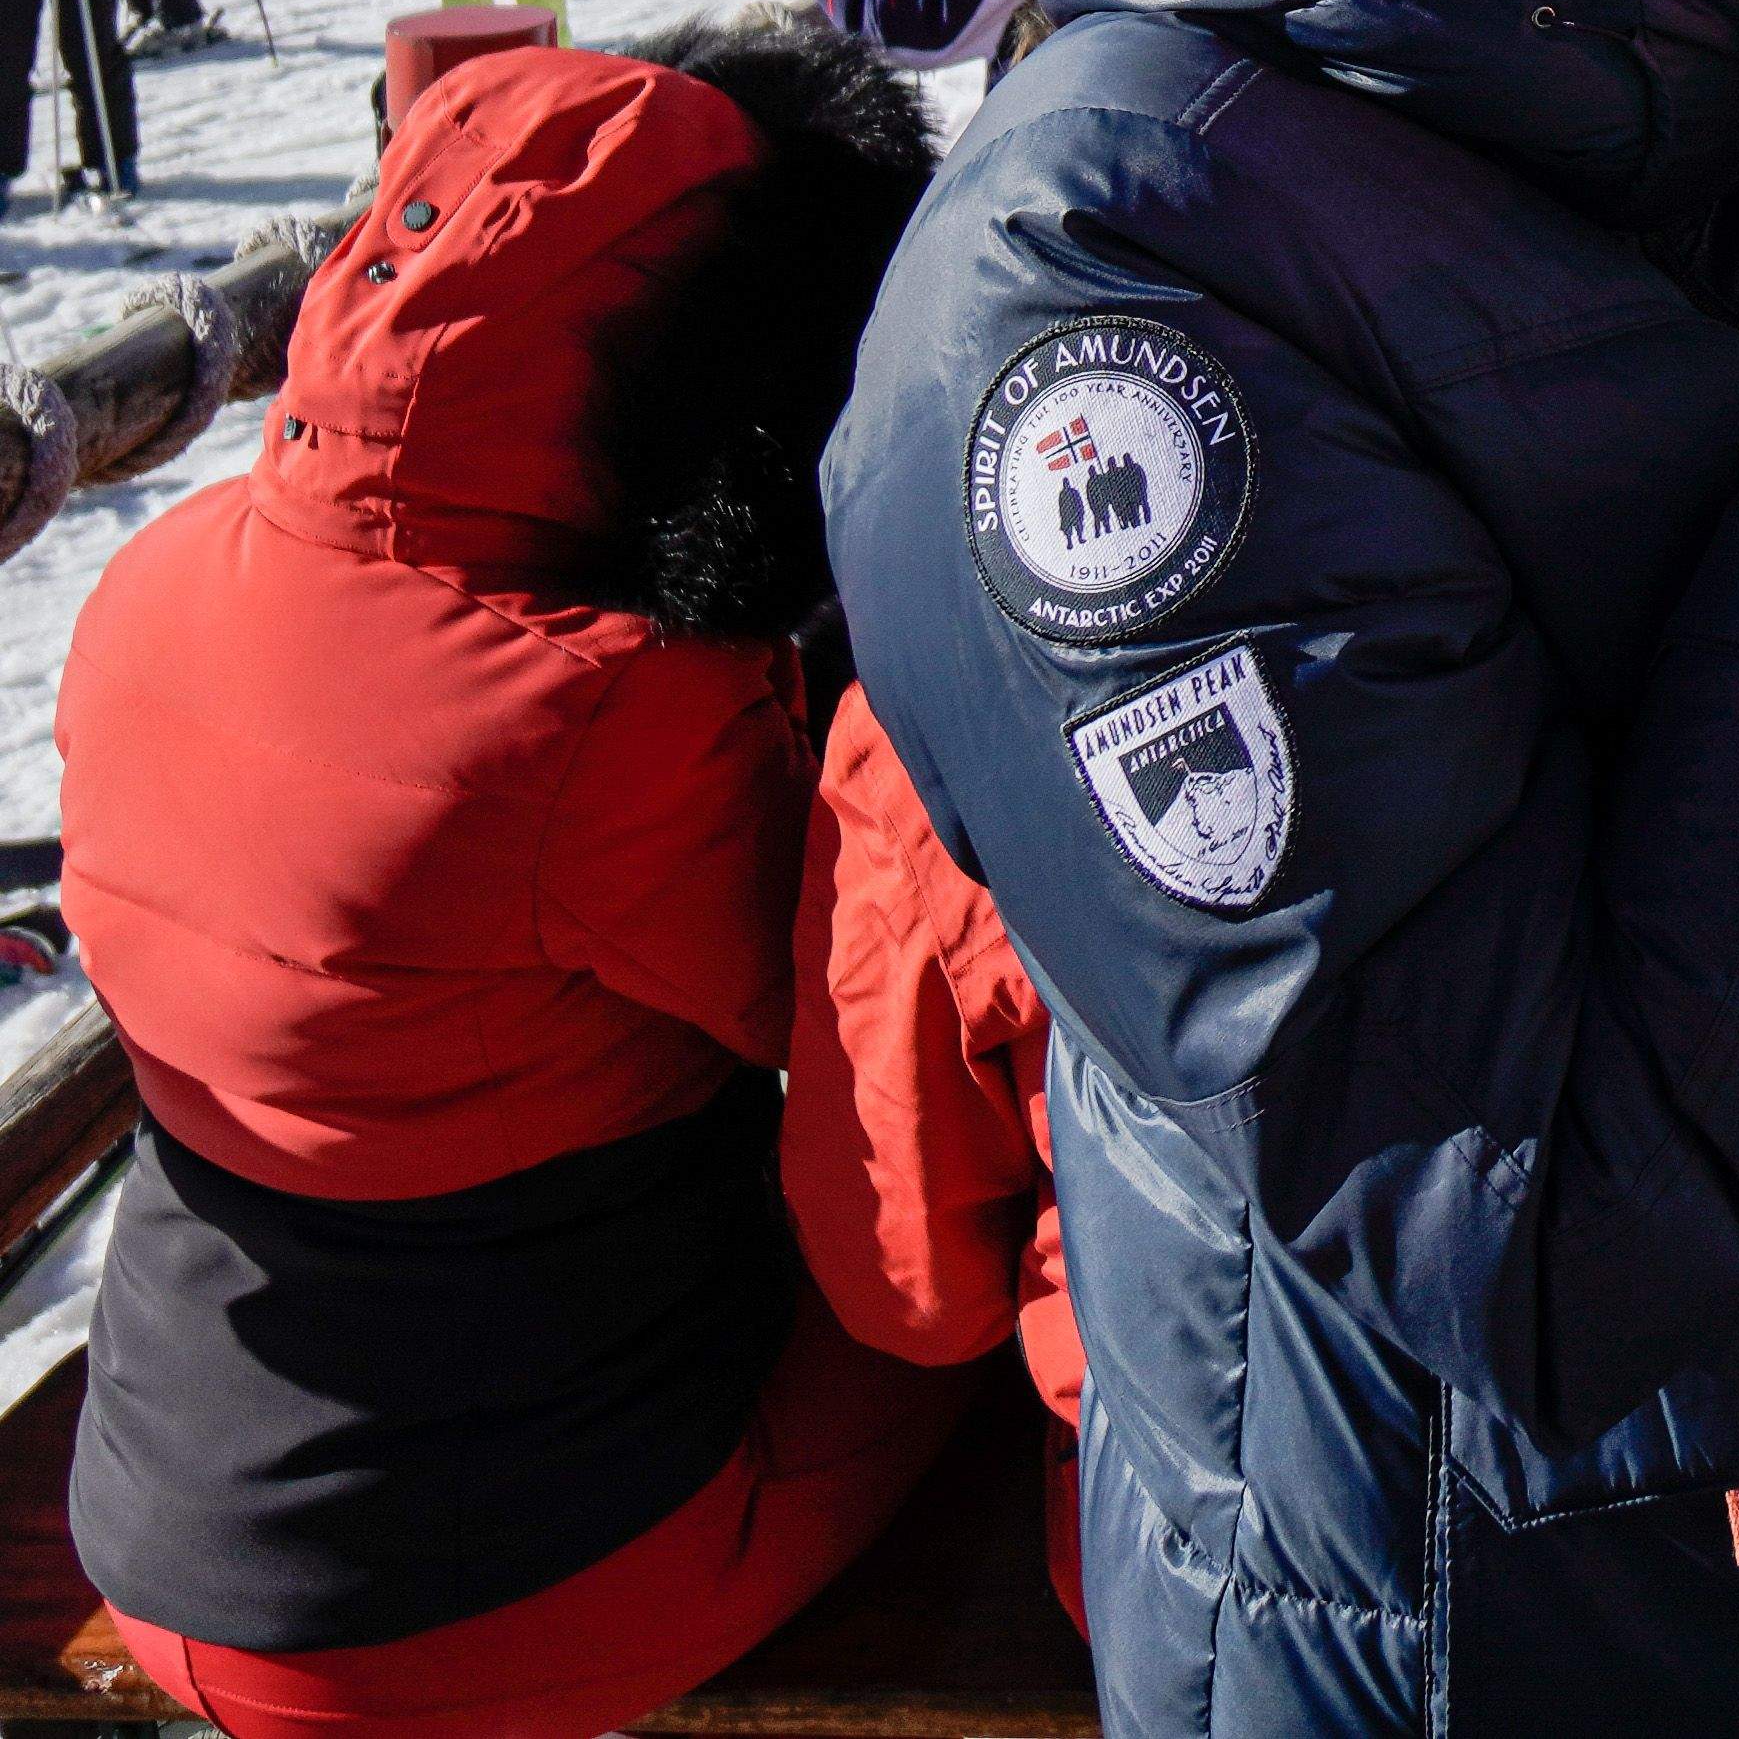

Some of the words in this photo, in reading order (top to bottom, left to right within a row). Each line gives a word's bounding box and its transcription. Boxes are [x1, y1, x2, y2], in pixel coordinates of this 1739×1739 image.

[973, 409, 1008, 534] SPIRIT
[1003, 358, 1041, 406] OF
[1053, 333, 1237, 447] AMUNDSEN
[1087, 382, 1130, 400] YEAR
[1131, 390, 1194, 485] ANNIVERSARY
[1027, 596, 1143, 629] ANTARCTIC
[1144, 572, 1184, 610] EXP
[1183, 534, 1219, 574] 2011
[1069, 532, 1168, 580] 1911-2011
[1085, 687, 1183, 761] AMUNDSEN
[1190, 652, 1247, 705] PEAK
[1129, 708, 1227, 774] ANTARCTICA
